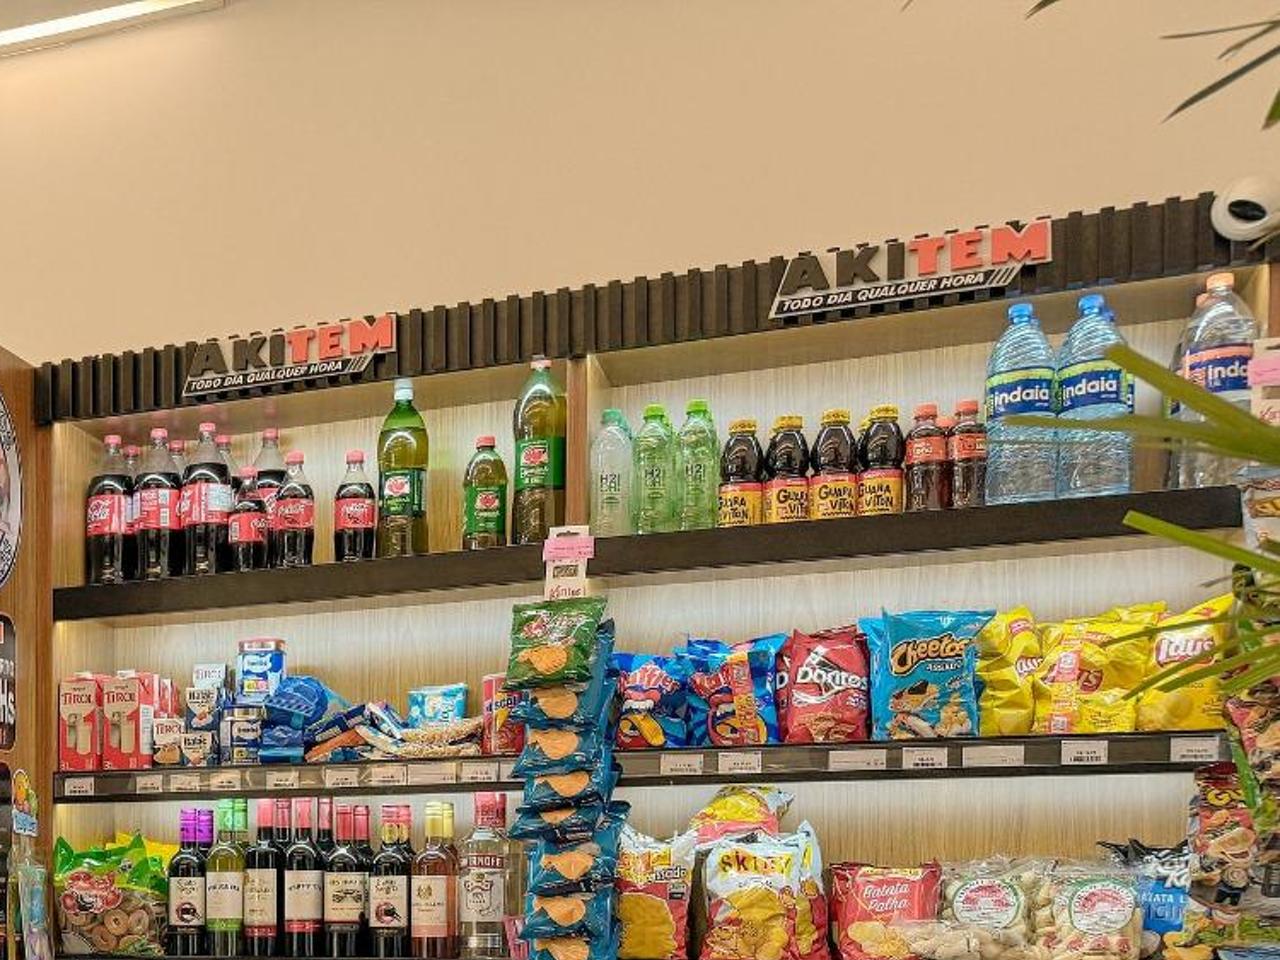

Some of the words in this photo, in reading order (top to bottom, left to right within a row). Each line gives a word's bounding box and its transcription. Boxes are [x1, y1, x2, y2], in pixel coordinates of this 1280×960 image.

[781, 220, 1051, 298] AKITEM
[782, 297, 824, 312] TODO
[827, 292, 852, 306] DIA
[857, 279, 938, 301] QUALQUER
[940, 272, 985, 289] HORA
[189, 315, 393, 376] AKITEM
[189, 379, 221, 392] TODO
[224, 375, 244, 387] DIA
[247, 365, 307, 383] QUALQUER
[309, 360, 343, 374] HORA
[1062, 377, 1118, 400] indaia
[863, 883, 910, 899] Batata
